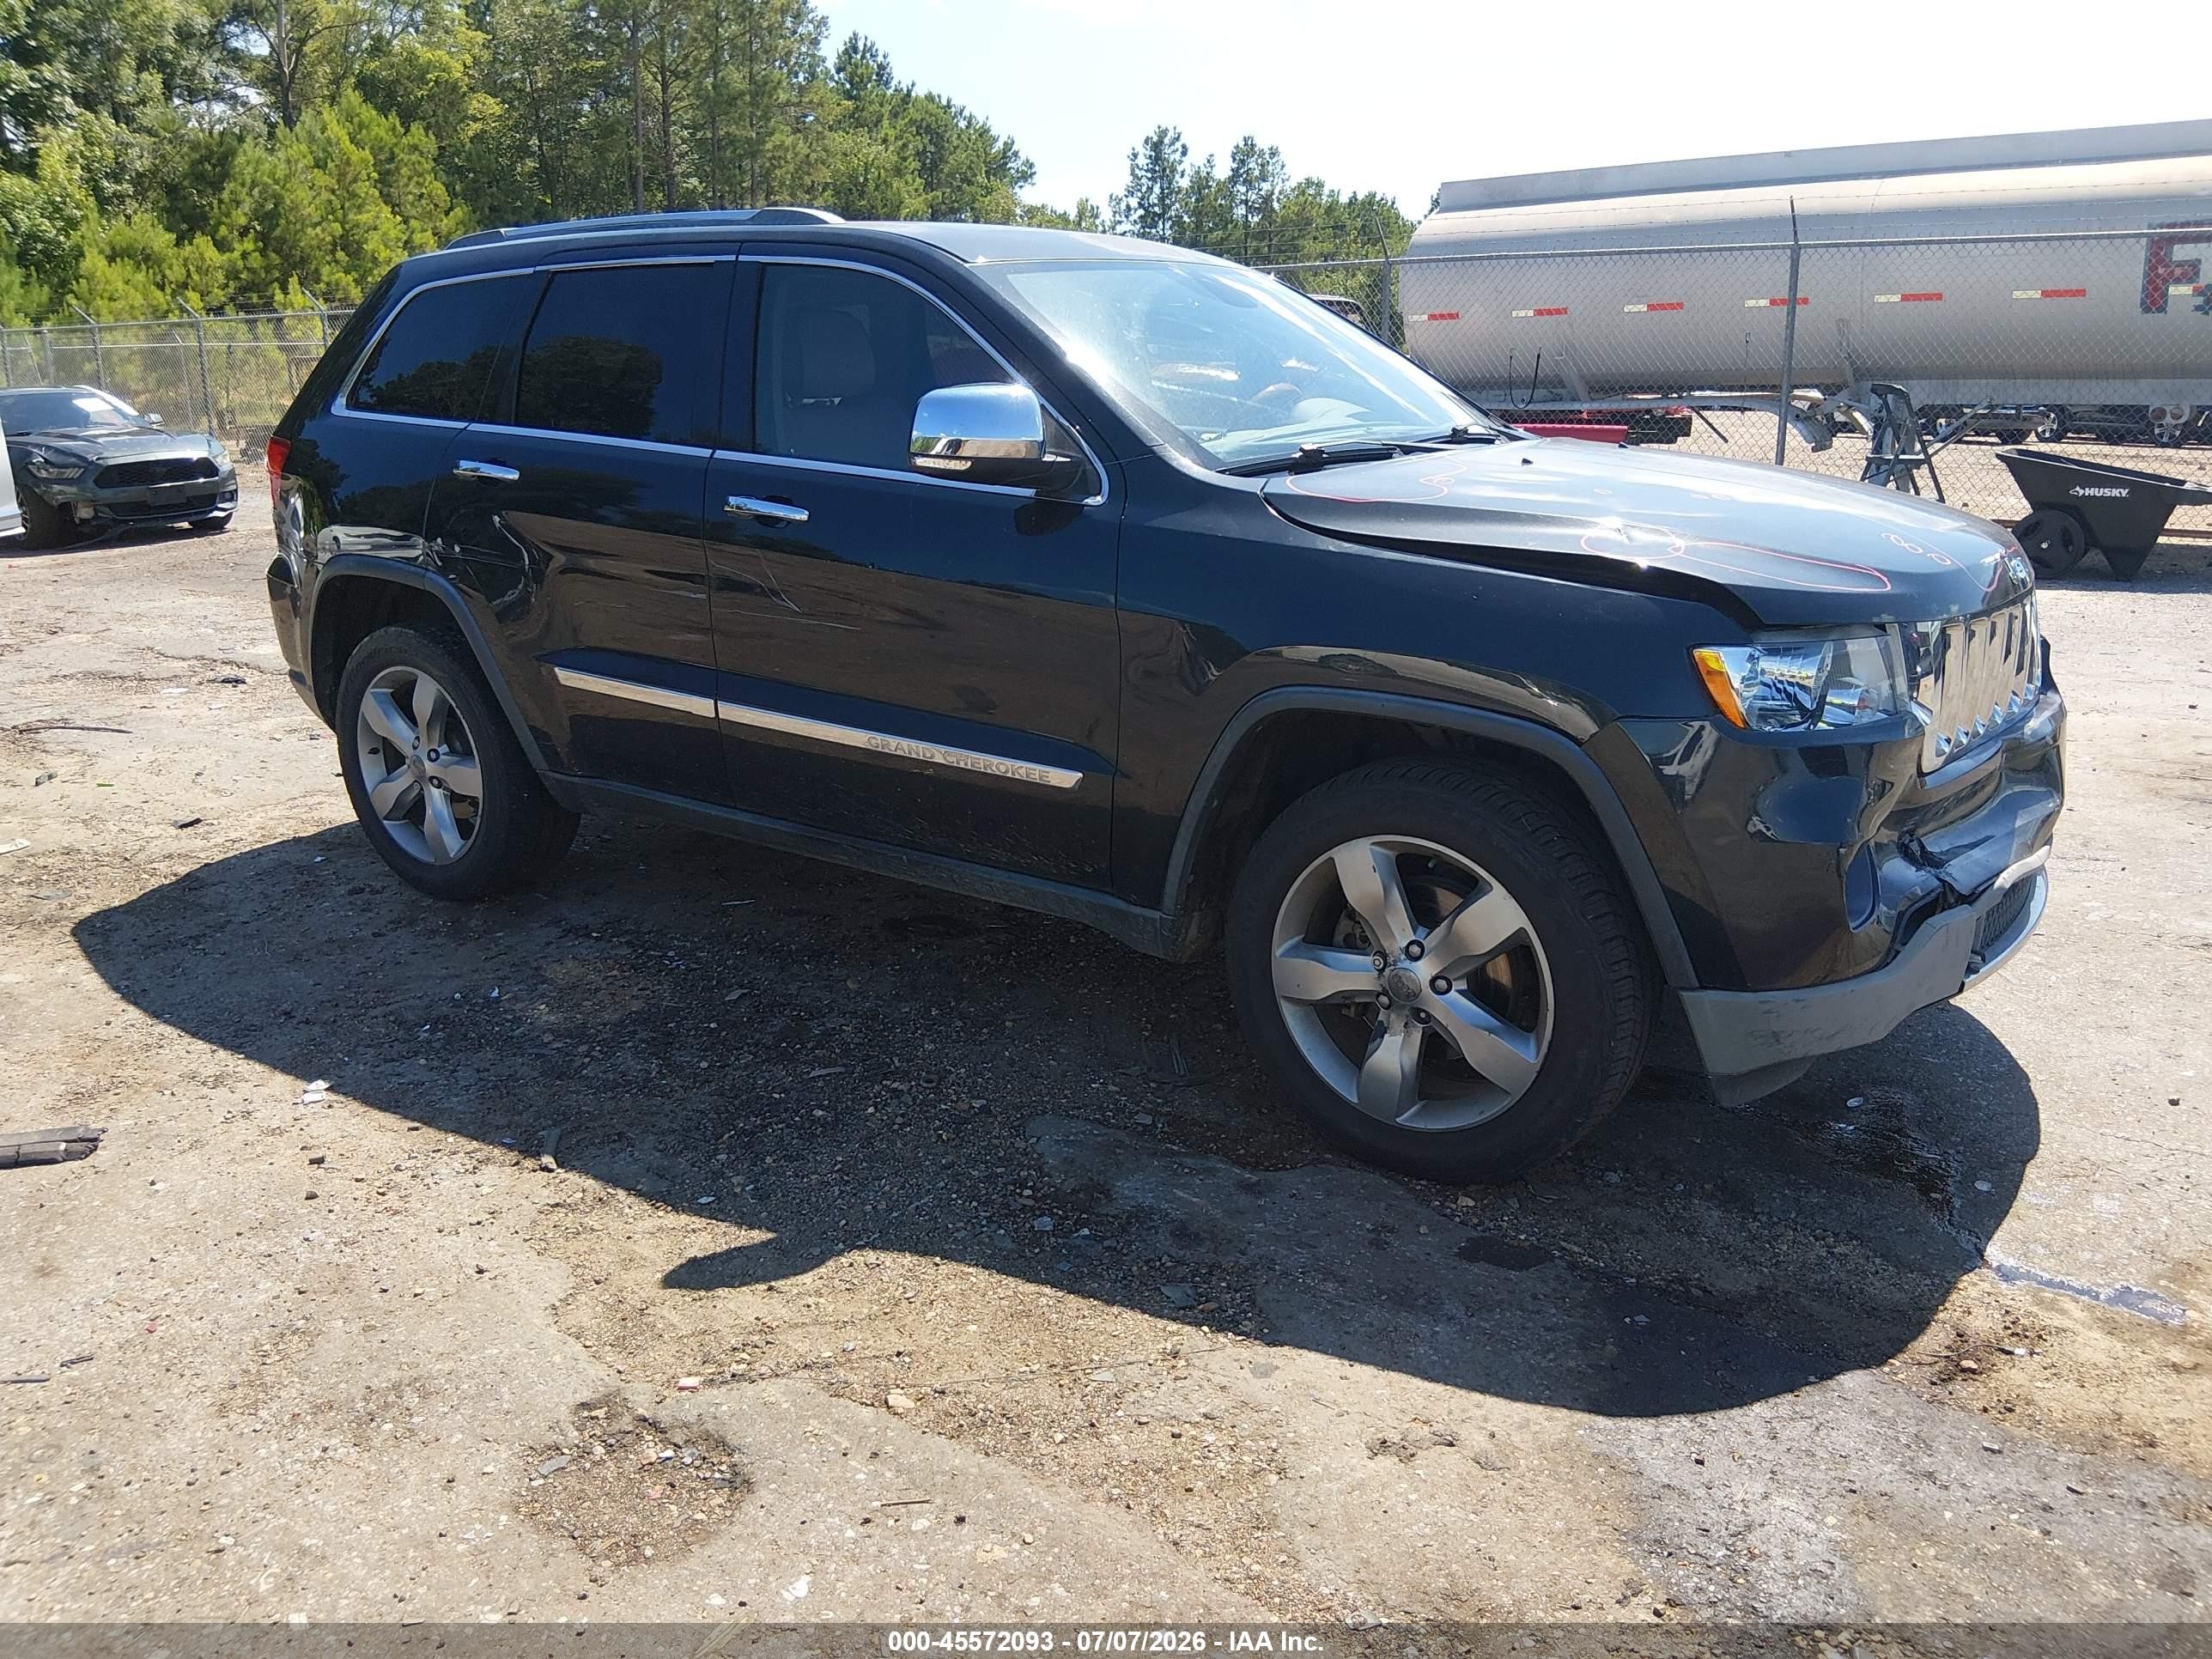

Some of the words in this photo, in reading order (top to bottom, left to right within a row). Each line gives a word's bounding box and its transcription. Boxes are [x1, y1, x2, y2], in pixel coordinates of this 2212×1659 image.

[2084, 487, 2130, 497] HUSKY
[866, 736, 935, 760] GRAND
[942, 750, 1051, 783] CHEROKEE
